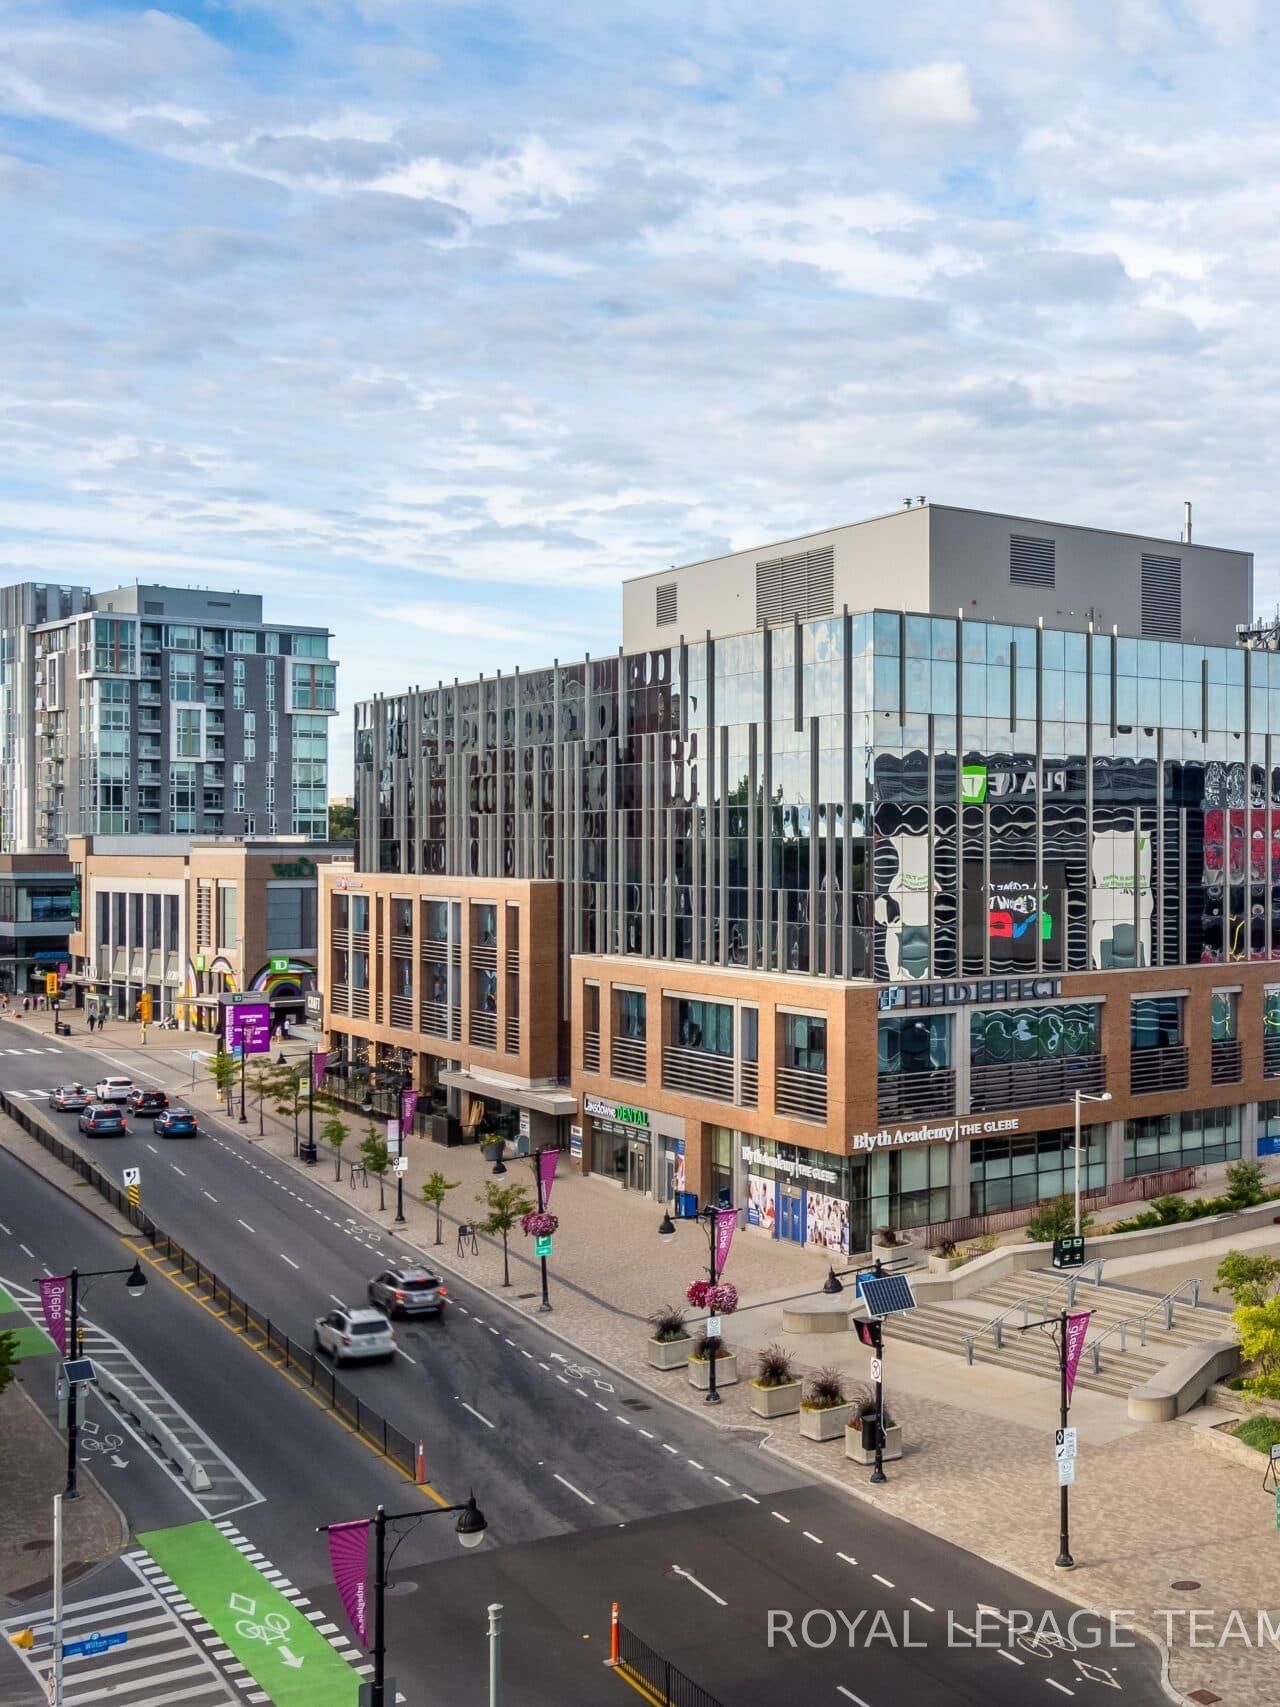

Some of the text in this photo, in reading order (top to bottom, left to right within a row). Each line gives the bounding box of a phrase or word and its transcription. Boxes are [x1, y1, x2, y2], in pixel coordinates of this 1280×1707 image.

[905, 982, 971, 1009] FIELD
[976, 976, 1062, 1003] EFFECT
[615, 1106, 649, 1126] DENTAL
[853, 1118, 1020, 1151] Blyth Academy THE GLEBE
[720, 1221, 729, 1249] glebe
[1068, 1325, 1081, 1361] glebe
[84, 1639, 108, 1651] Wilton
